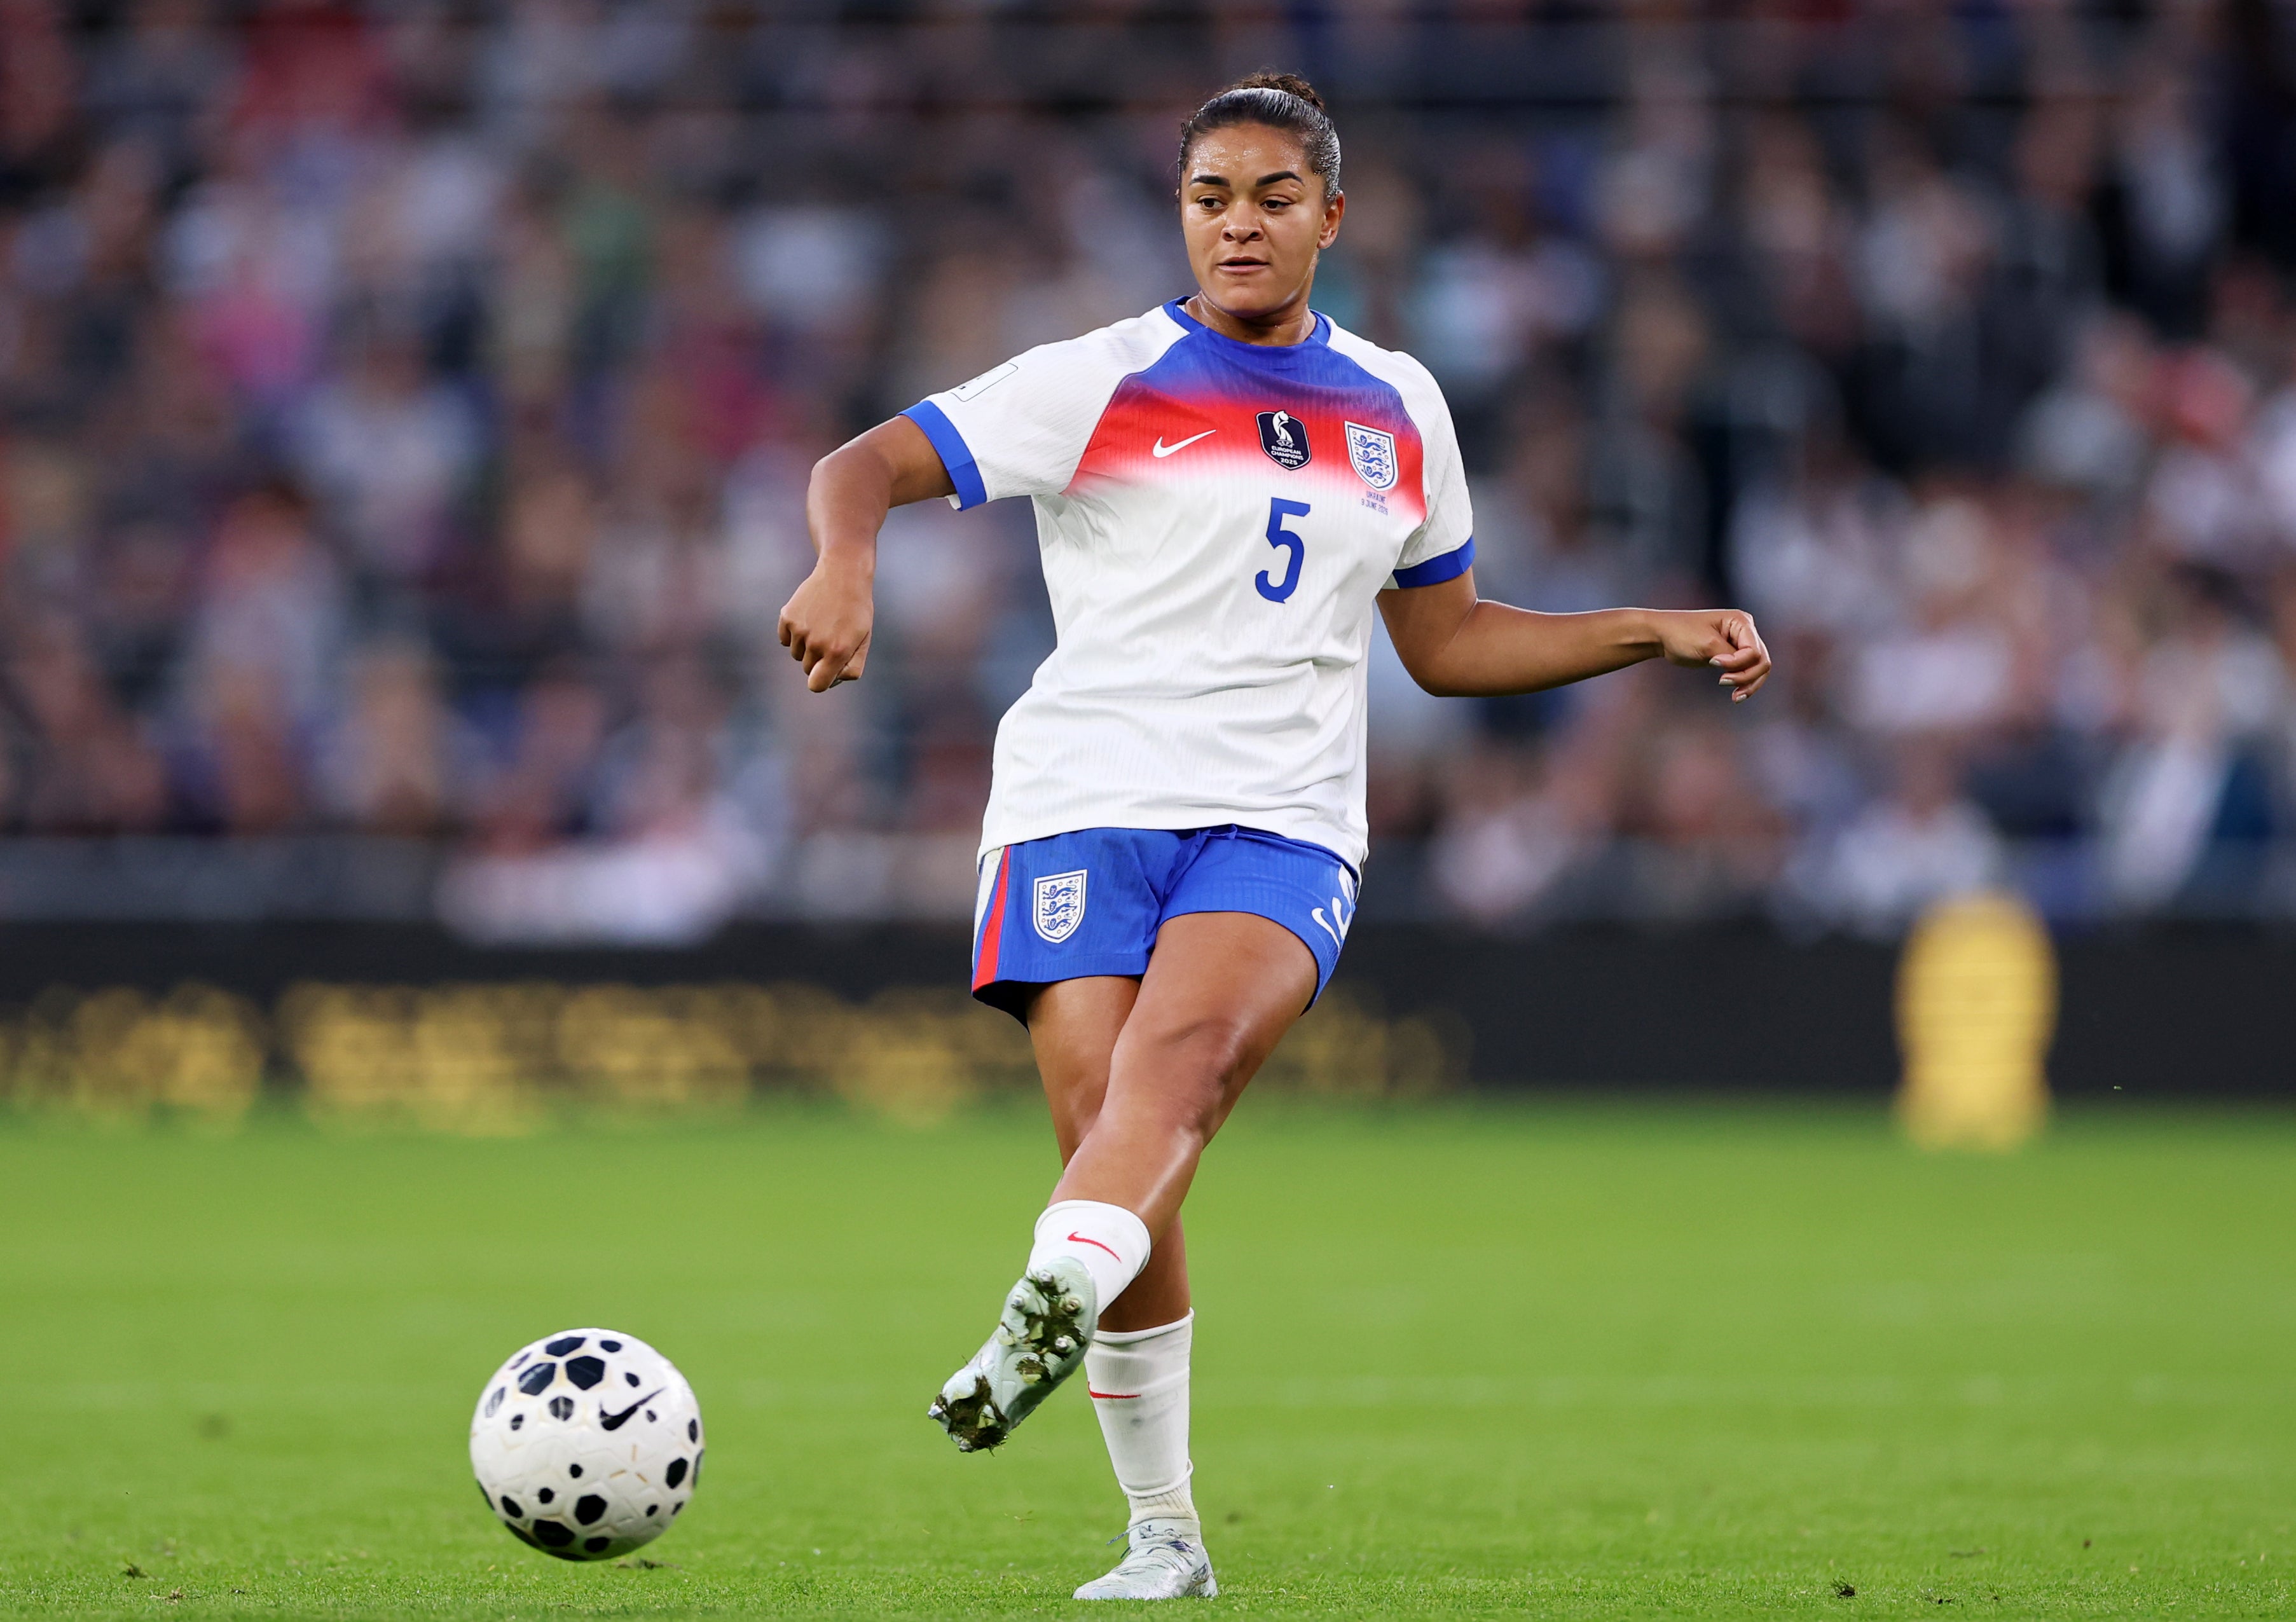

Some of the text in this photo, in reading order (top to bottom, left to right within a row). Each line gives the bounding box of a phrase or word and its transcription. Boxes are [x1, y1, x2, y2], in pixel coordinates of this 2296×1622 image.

[1270, 450, 1304, 461] CHAMPIONS
[1271, 445, 1302, 455] EUROPEAN
[1280, 457, 1298, 465] 2025
[1366, 490, 1386, 504] UKRAINE
[1365, 499, 1377, 511] JUNE
[1255, 497, 1310, 604] 5
